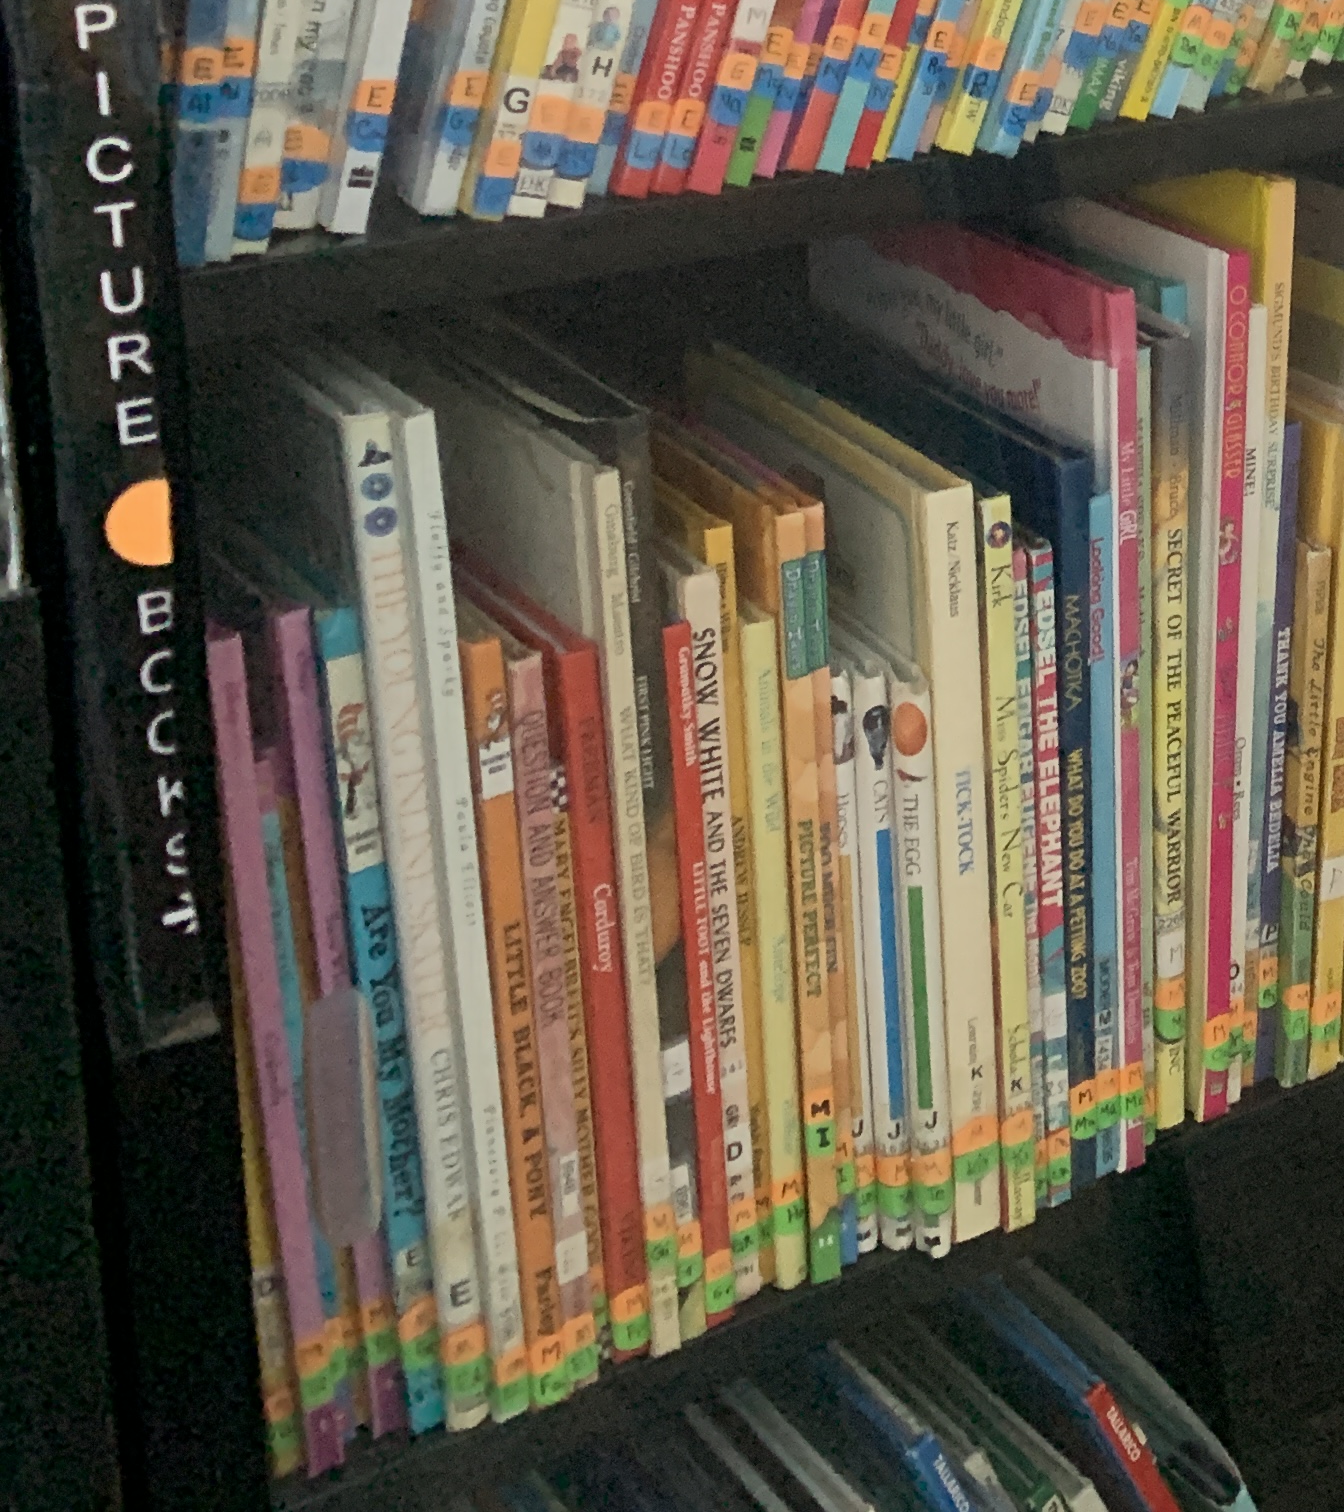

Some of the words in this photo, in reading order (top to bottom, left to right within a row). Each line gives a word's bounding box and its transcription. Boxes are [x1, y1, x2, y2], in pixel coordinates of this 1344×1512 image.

[503, 87, 531, 115] G
[73, 3, 160, 447] PICTURE
[1244, 447, 1257, 497] MINE!
[1119, 510, 1139, 545] GIRL
[990, 563, 1014, 609] Kirk
[1166, 528, 1183, 605] SECRET
[1034, 588, 1057, 687] EDSEL
[1064, 594, 1082, 712] MACHOTKA
[1166, 613, 1183, 640] OF
[1275, 627, 1291, 685] THANK
[692, 627, 720, 706] SNOW
[1166, 649, 1182, 693] THE
[1036, 689, 1059, 757] THE
[1273, 686, 1288, 727] YOU
[698, 717, 726, 804] WHITE
[1067, 747, 1083, 791] WHAT
[1166, 700, 1183, 803] PEACEFUL
[1270, 727, 1285, 798] AMELIA
[1303, 743, 1320, 817] Engine
[872, 779, 891, 824] CATS
[902, 794, 919, 831] THE
[954, 767, 975, 877] TICK-TOCK
[706, 811, 726, 854] AND
[903, 839, 922, 877] EGG
[1000, 828, 1022, 873] New
[1036, 757, 1063, 908] ELEPHANT
[1166, 808, 1183, 907] WARRIOR
[1266, 801, 1283, 875] BEDELIA
[708, 858, 729, 897] THE
[1001, 881, 1023, 920] Car
[361, 905, 390, 961] Are
[592, 882, 614, 974] Corduroy
[710, 903, 732, 966] SEVEN
[1069, 908, 1086, 962] PETTING
[369, 970, 400, 1029] You
[716, 969, 737, 1048] DWARFS
[503, 920, 528, 1016] LITTLE
[525, 1152, 548, 1221] PONY
[1105, 1404, 1142, 1464] TALLARICO
